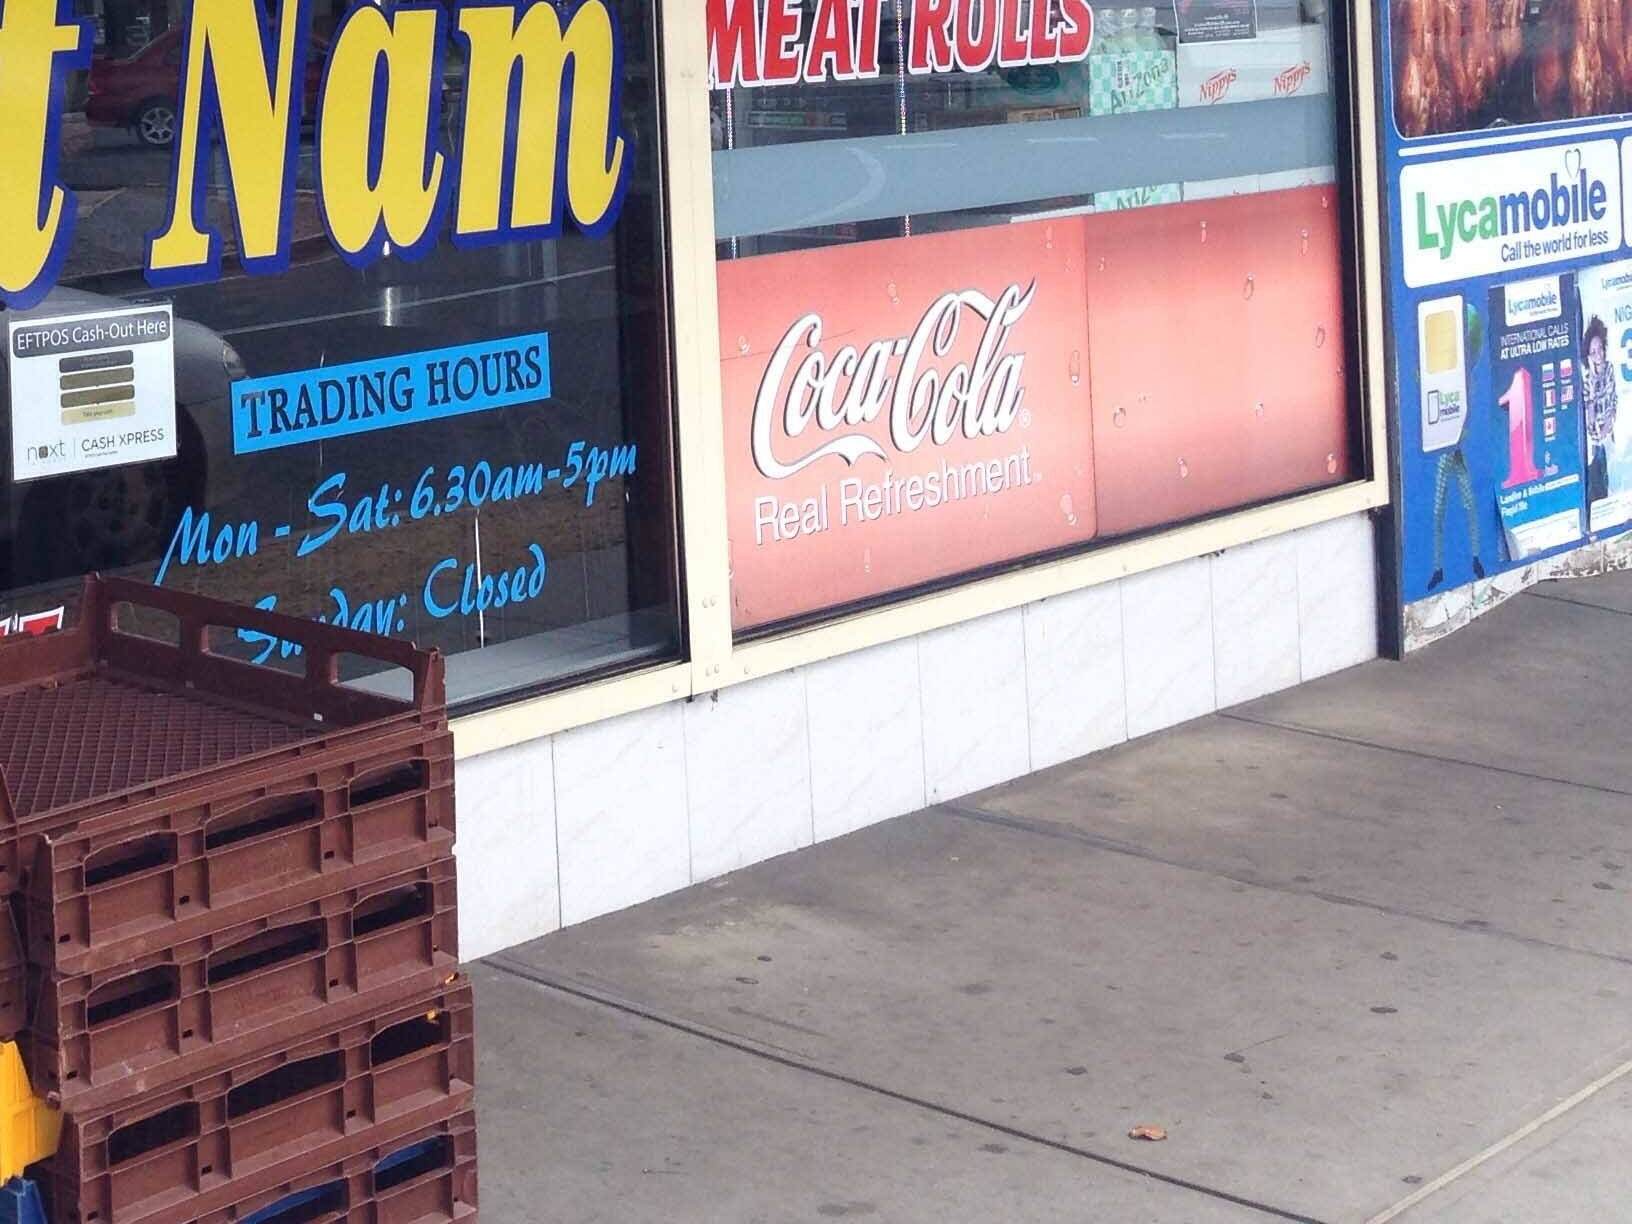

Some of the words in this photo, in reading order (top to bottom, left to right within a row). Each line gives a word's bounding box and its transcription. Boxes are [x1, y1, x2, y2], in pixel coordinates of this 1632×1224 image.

[1415, 167, 1608, 260] Lycamobile
[1501, 242, 1522, 262] Call
[1524, 240, 1541, 258] the
[1542, 232, 1572, 255] world
[1574, 231, 1587, 249] for
[1589, 229, 1609, 246] less
[1508, 290, 1558, 316] Lycamobile
[17, 328, 68, 350] EFTPOS
[72, 322, 133, 344] Cash-Out
[137, 319, 167, 335] Here
[1500, 327, 1547, 347] INTERNATIONAL
[1548, 323, 1569, 338] CALLS
[1500, 348, 1510, 360] AT
[1511, 342, 1531, 358] ULTRA
[1533, 338, 1547, 353] LOW
[1548, 334, 1569, 350] RATES
[241, 366, 414, 437] TRADING
[425, 345, 543, 408] HOURS
[81, 435, 115, 452] CASH
[119, 428, 165, 446] XPRESS
[154, 505, 258, 585] Mon
[297, 472, 402, 558] Sat:
[754, 487, 829, 545] Real
[236, 587, 408, 664] Sday:
[423, 543, 548, 620] Closed
